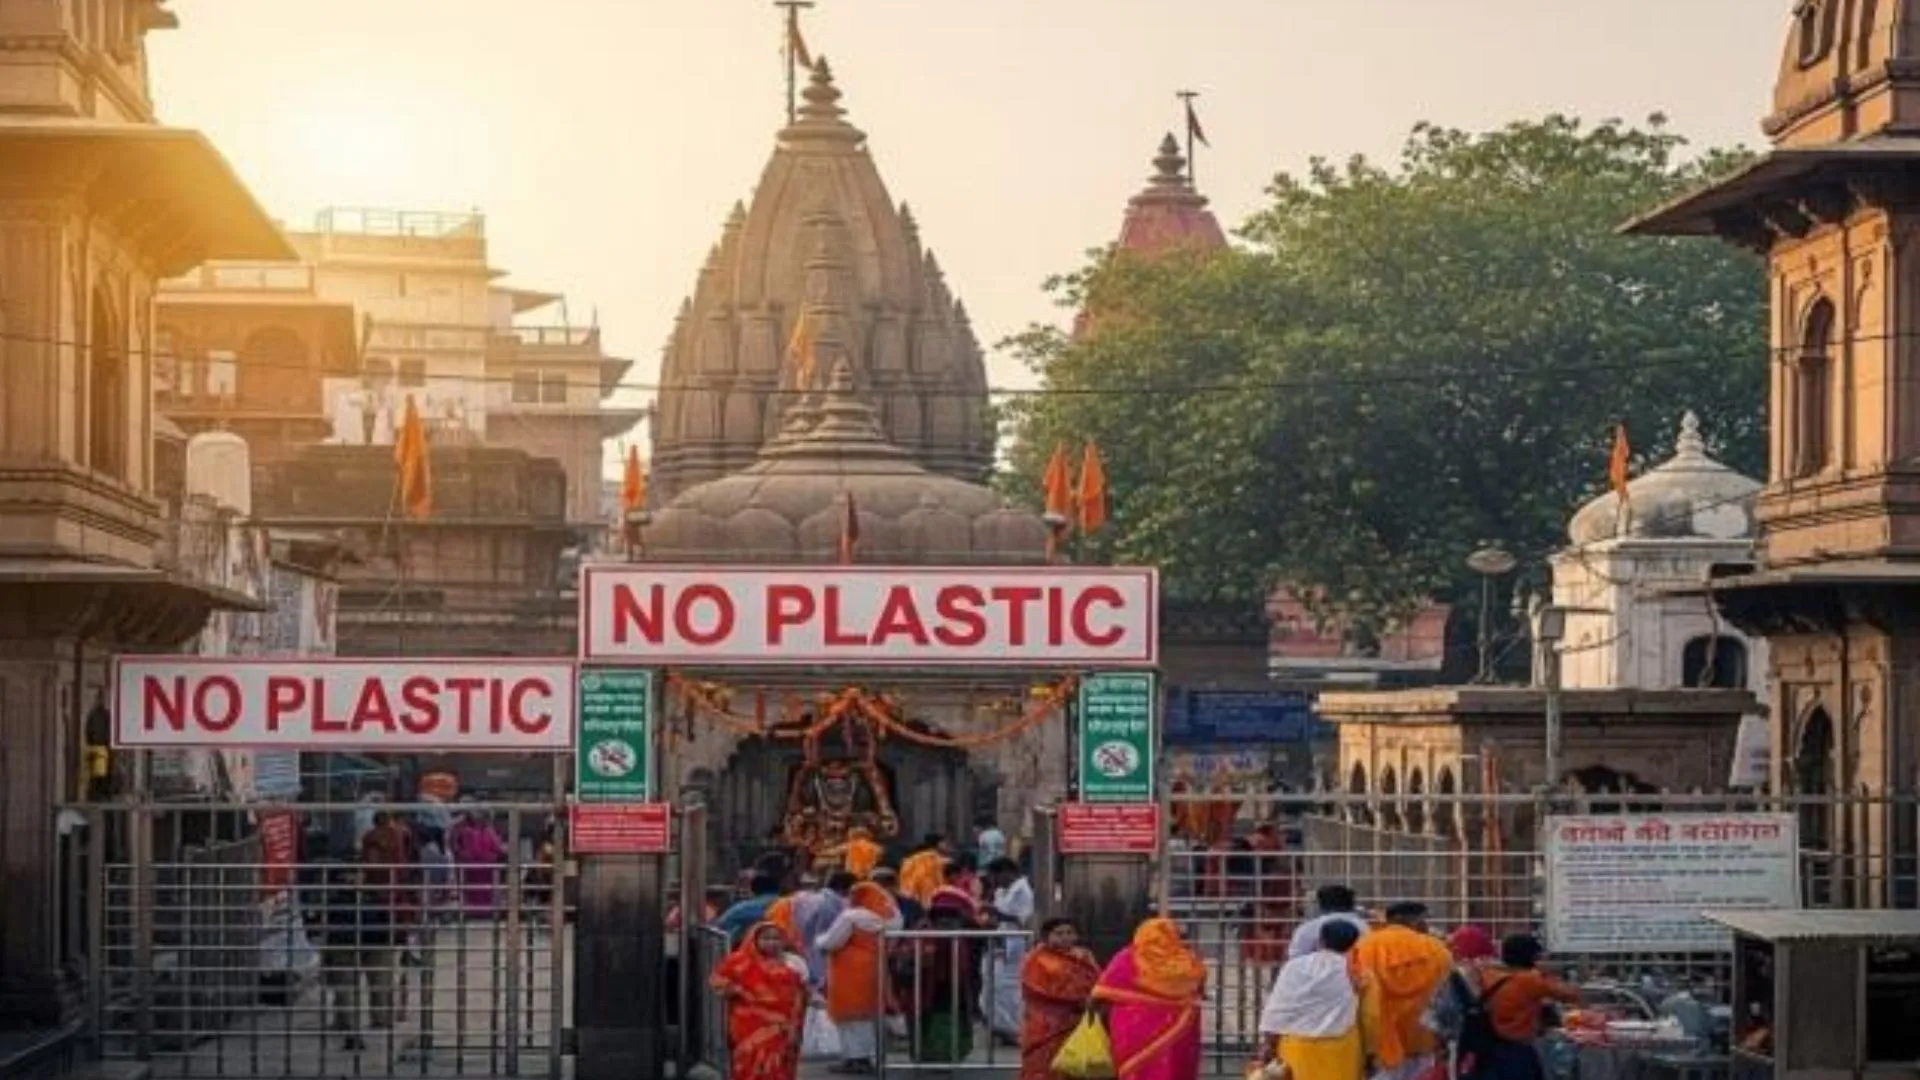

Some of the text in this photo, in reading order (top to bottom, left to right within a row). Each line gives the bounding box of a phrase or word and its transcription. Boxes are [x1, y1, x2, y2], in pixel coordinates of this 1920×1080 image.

[611, 583, 1127, 647] NO PLASTIC
[143, 675, 552, 734] NO PLASTIC
